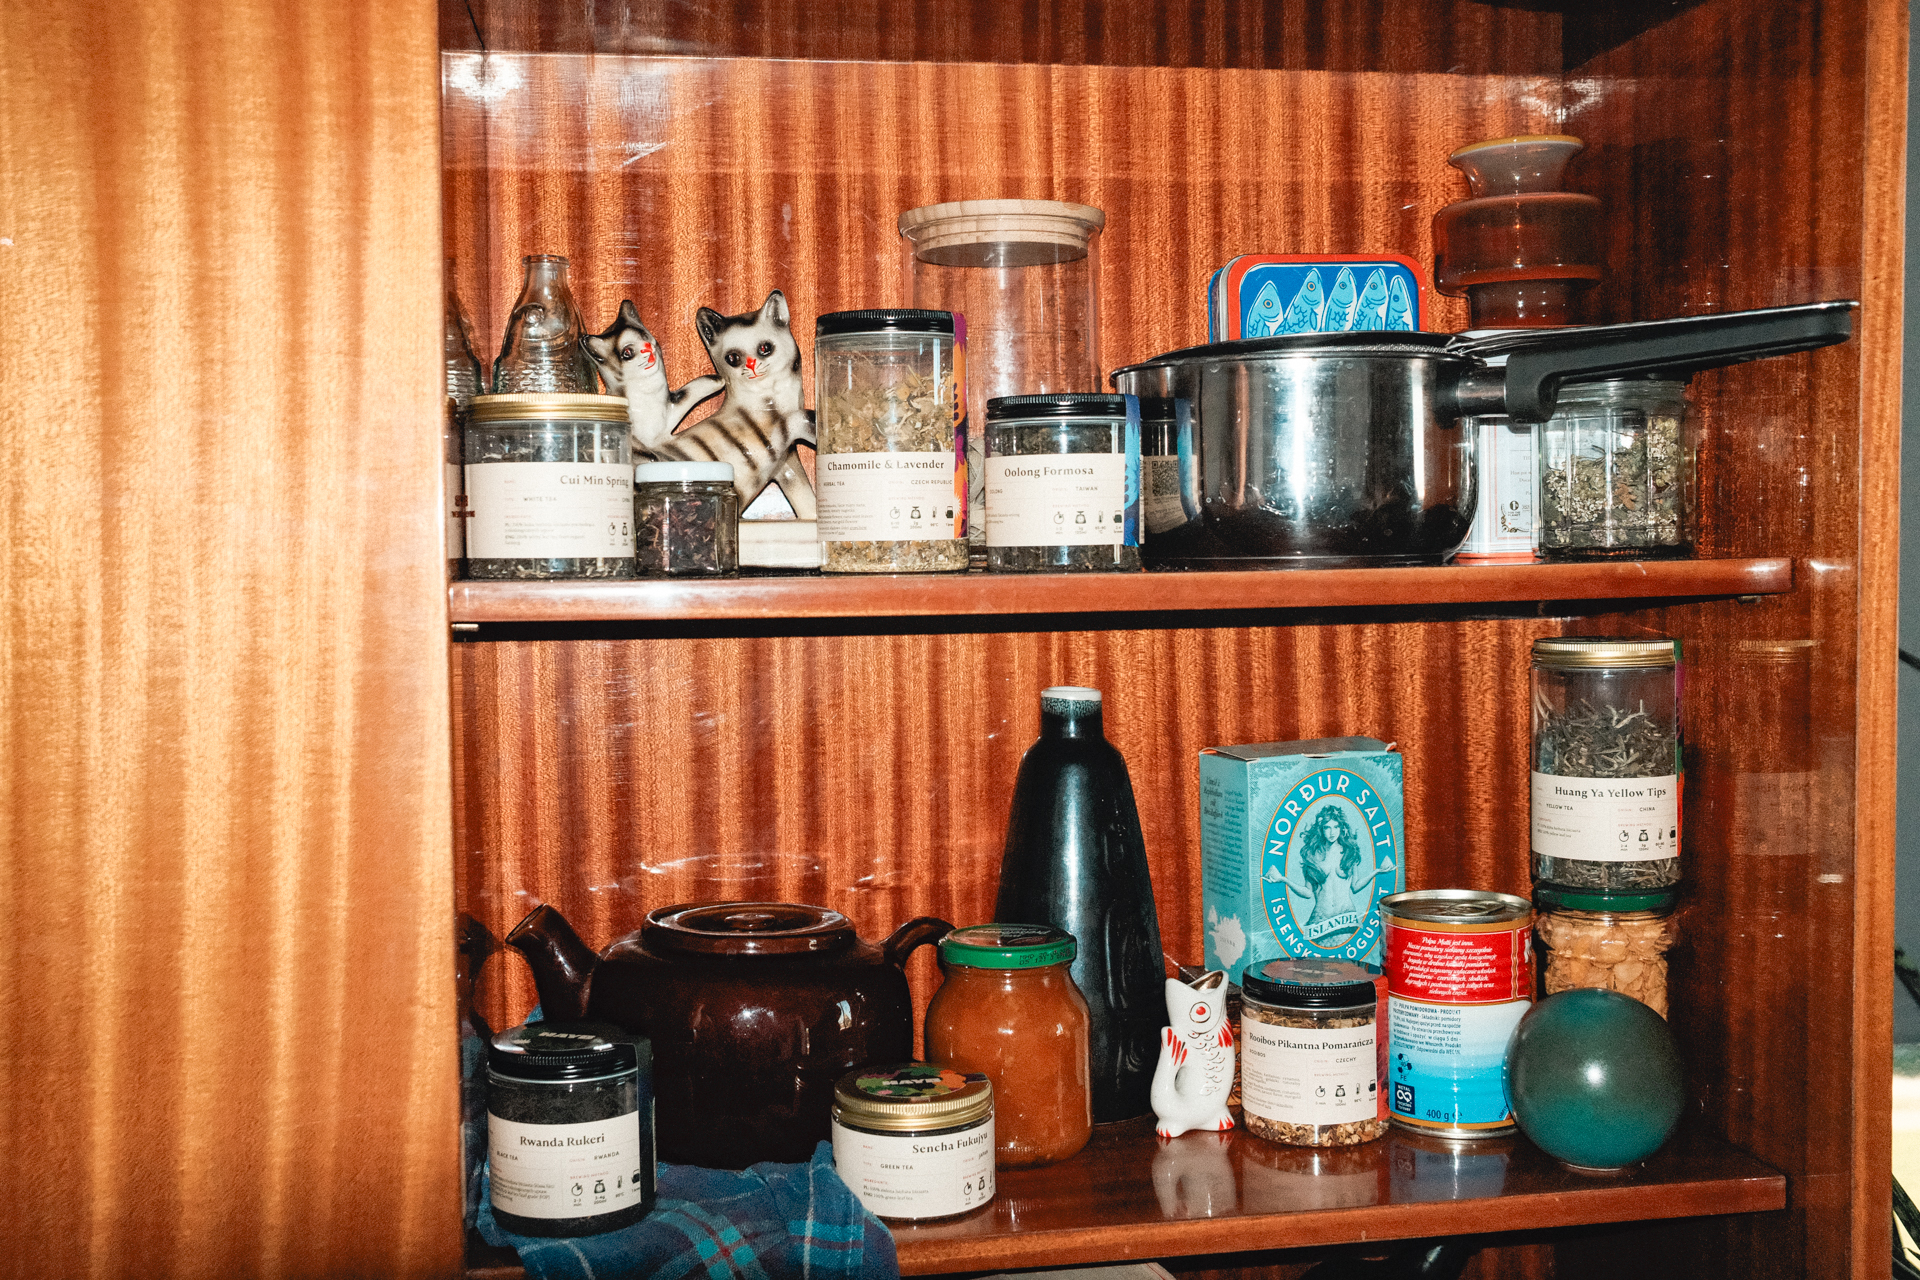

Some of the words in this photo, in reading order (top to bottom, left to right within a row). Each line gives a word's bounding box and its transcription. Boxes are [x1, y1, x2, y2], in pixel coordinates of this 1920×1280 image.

[827, 460, 880, 471] Chamomile
[884, 460, 893, 469] &
[896, 460, 944, 469] Lavender
[1004, 467, 1040, 479] Oolong
[1044, 466, 1094, 476] Formosa
[560, 475, 580, 485] Cui
[584, 475, 604, 485] Min
[606, 476, 629, 488] Spring
[1555, 786, 1588, 799] Huang
[1591, 789, 1604, 797] Ya
[1608, 789, 1644, 797] Yellow
[1647, 787, 1666, 799] Tips
[1356, 789, 1391, 848] SALT
[1308, 914, 1359, 938] ISLANDIA
[1249, 1032, 1276, 1046] Rooibos
[1277, 1039, 1320, 1050] Pikantna
[1322, 1038, 1374, 1050] Pomarańcza
[1426, 1109, 1441, 1119] 400
[1444, 1113, 1449, 1122] g
[520, 1136, 564, 1147] Rwanda
[567, 1133, 605, 1146] Rukeri
[912, 1142, 954, 1154] Sencha
[957, 1131, 988, 1149] Fukujyu
[594, 1151, 619, 1160] RWANDA
